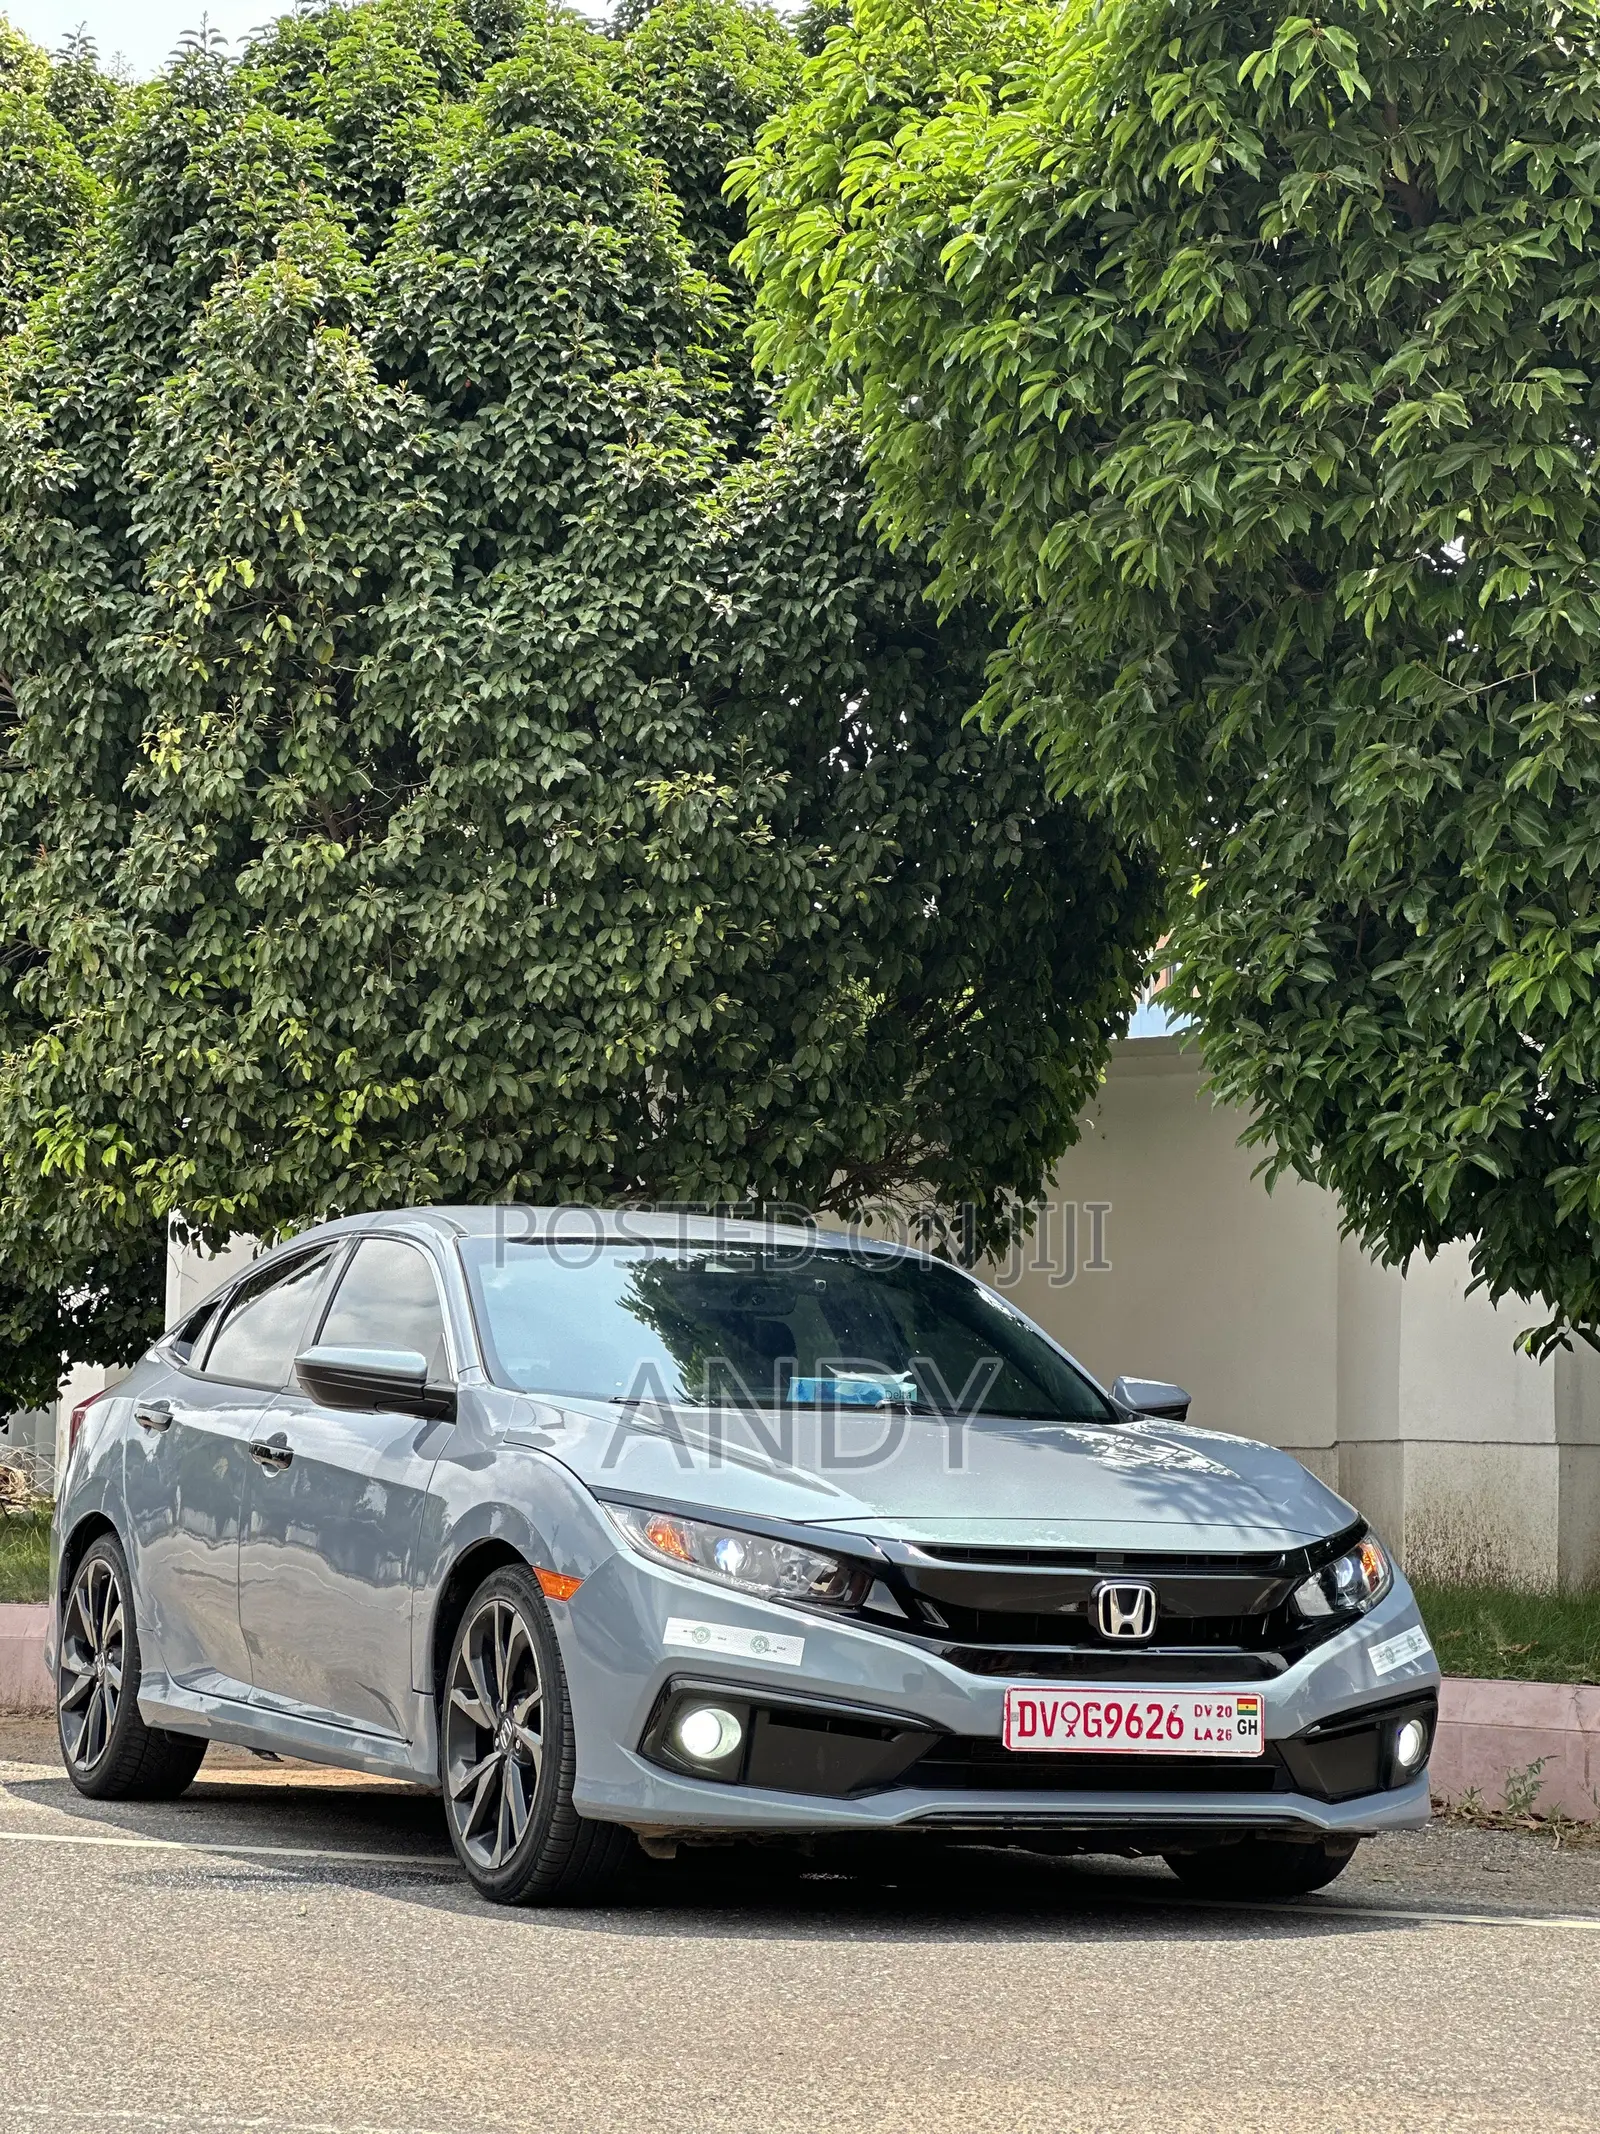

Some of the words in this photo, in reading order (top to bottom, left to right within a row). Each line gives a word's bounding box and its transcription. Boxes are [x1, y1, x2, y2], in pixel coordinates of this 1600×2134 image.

[1194, 1704, 1212, 1718] DV
[1216, 1704, 1233, 1718] 20
[1194, 1727, 1214, 1741] LA
[1216, 1728, 1233, 1742] 26
[1236, 1718, 1258, 1736] GH
